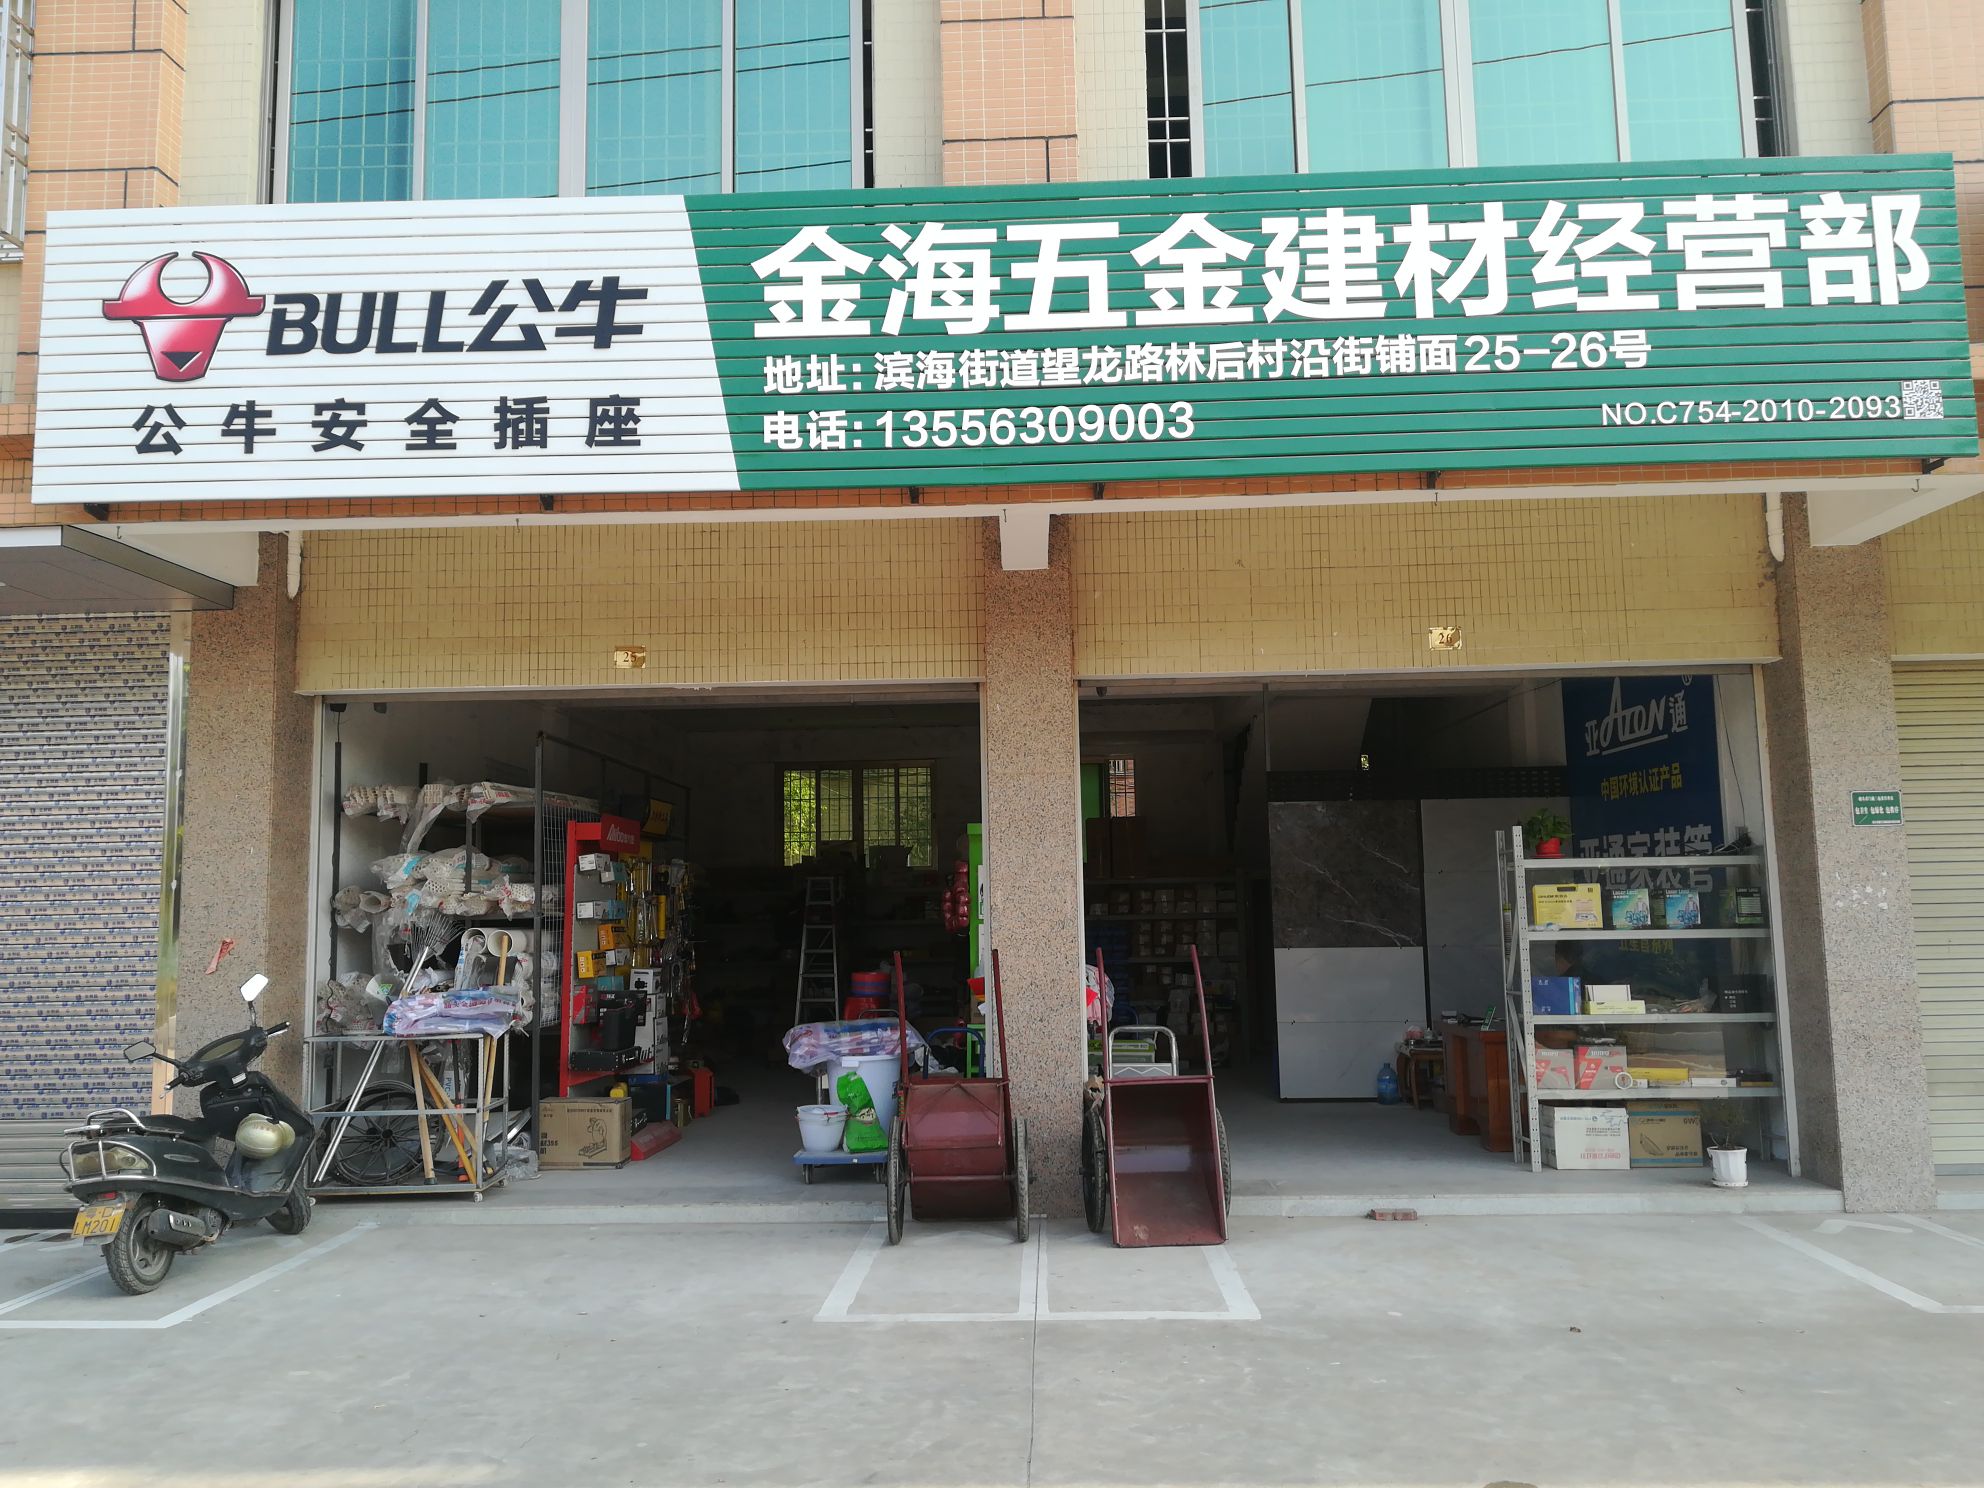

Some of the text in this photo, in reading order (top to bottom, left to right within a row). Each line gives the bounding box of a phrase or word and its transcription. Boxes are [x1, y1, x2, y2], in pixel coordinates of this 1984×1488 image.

[751, 191, 1931, 338] 金海五金建材经营部
[267, 276, 648, 356] BULL公牛
[131, 395, 642, 455] 公牛安全插座
[1601, 396, 1901, 427] NO.C754-2010-2093
[623, 651, 637, 663] 25
[1438, 632, 1453, 645] 26
[1600, 763, 1682, 801] 中国环境认证产品
